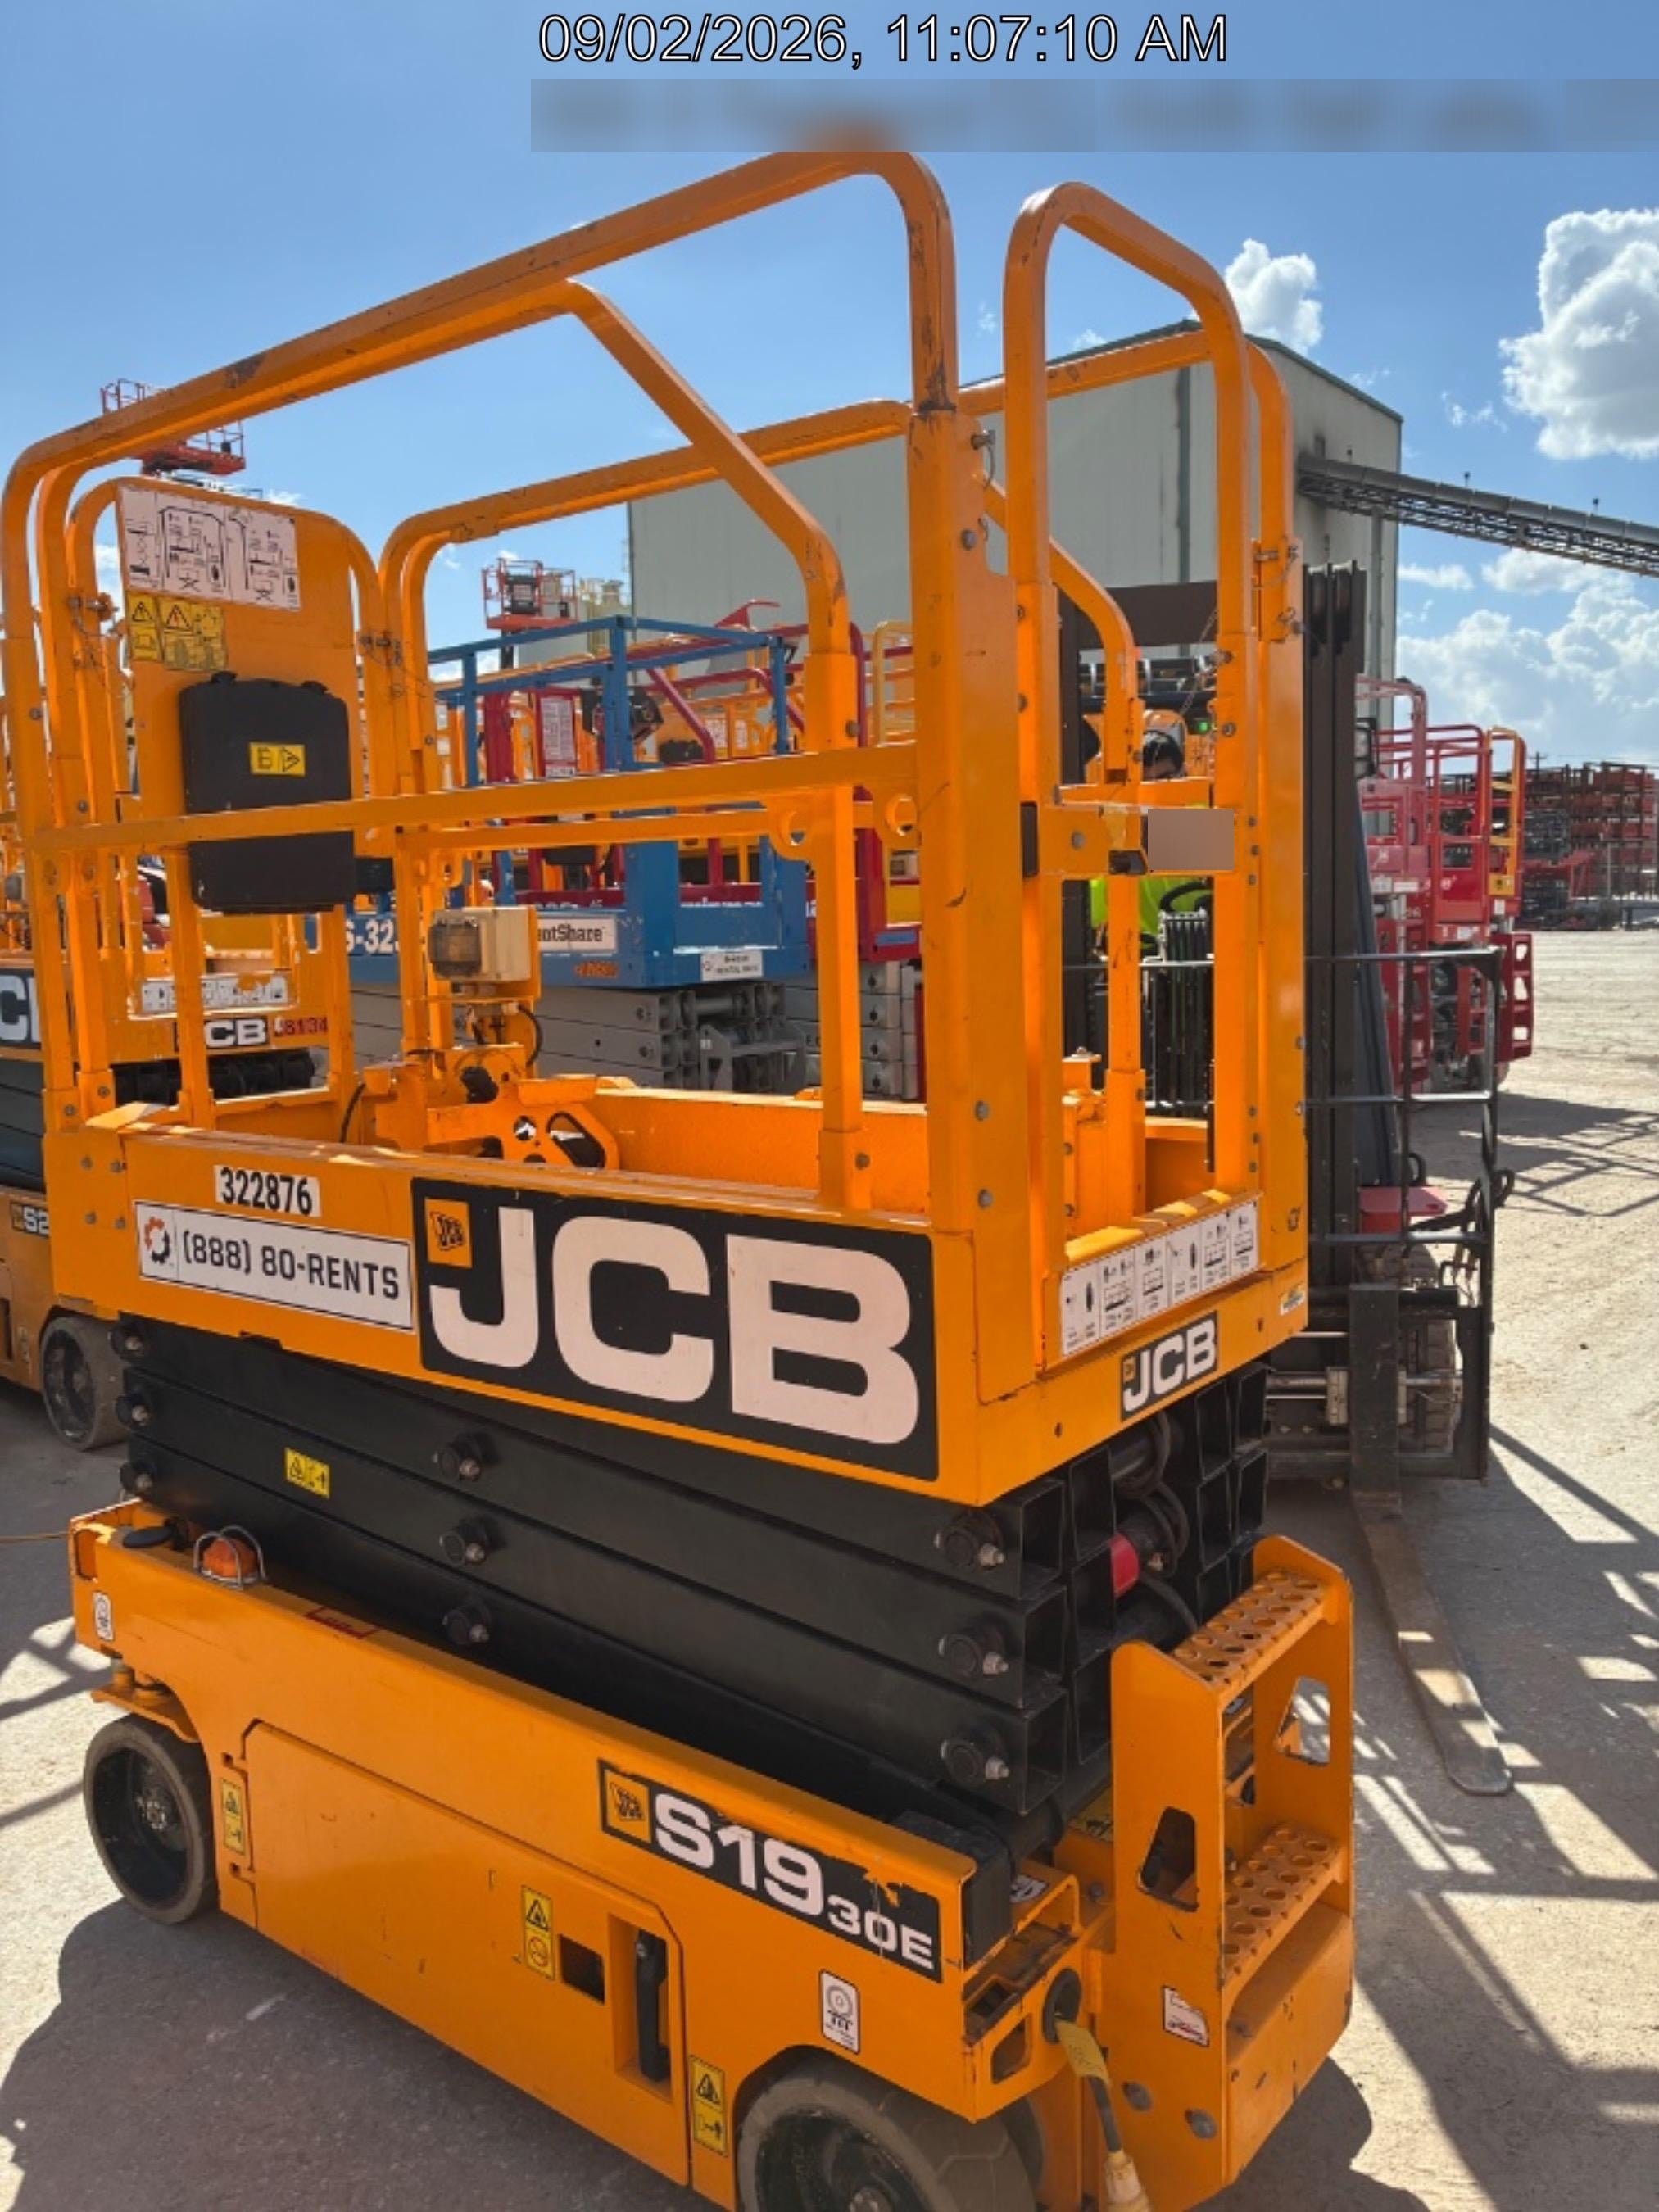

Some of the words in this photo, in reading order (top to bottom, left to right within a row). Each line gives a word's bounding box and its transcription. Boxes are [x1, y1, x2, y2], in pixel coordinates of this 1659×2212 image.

[220, 1167, 313, 1216] 322876
[183, 1231, 251, 1275] (888)
[261, 1245, 399, 1300] 80-RENTS
[429, 1207, 920, 1444] JCB
[1123, 1319, 1216, 1411] JCB
